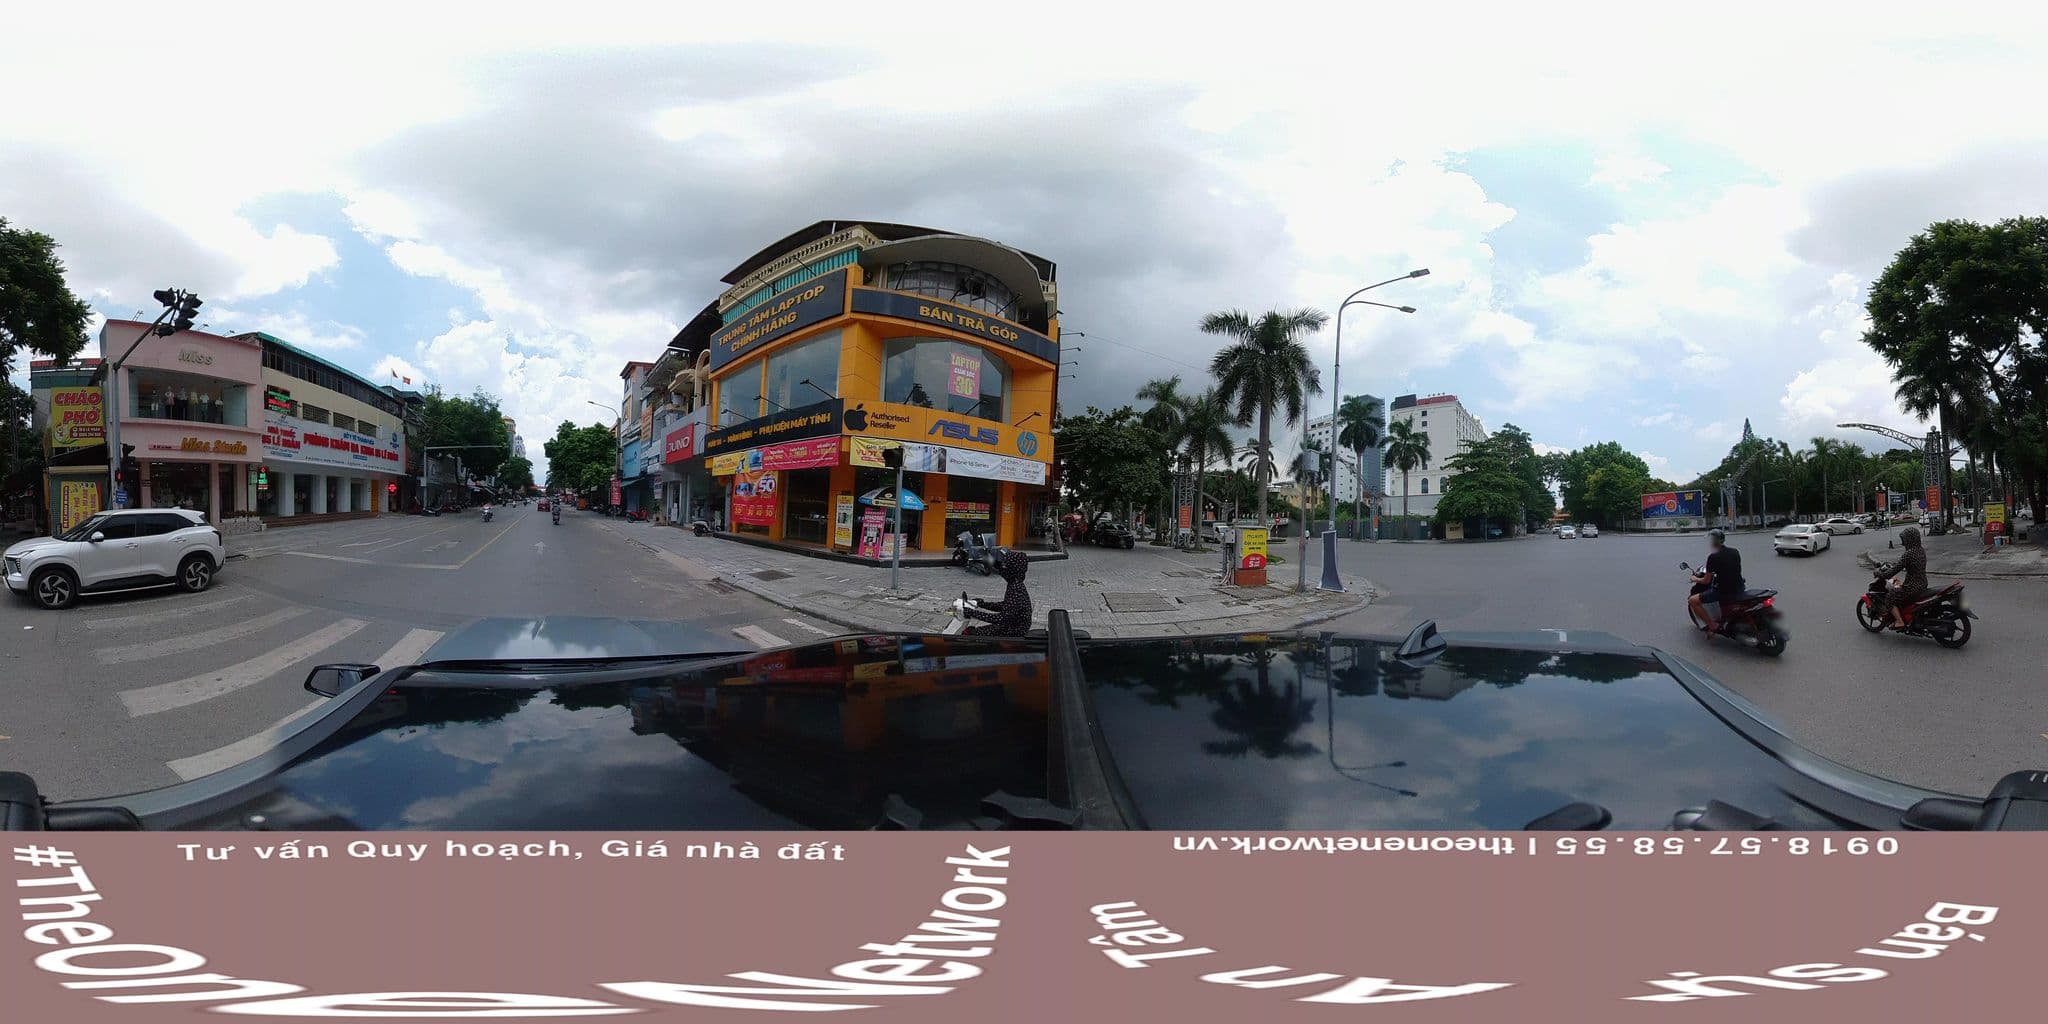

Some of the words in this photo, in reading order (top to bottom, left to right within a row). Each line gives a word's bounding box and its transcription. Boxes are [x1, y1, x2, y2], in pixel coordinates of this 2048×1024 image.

[718, 321, 747, 346] TRUNG
[748, 308, 769, 329] TÂM
[769, 284, 826, 320] LAPTOP
[918, 304, 954, 323] BÁN
[957, 312, 985, 331] TRẢ
[989, 325, 1019, 342] GÓP
[731, 327, 760, 353] CHÍNH
[760, 311, 797, 339] HÃNG
[179, 349, 213, 366] Miss
[952, 355, 980, 370] LAPTOP
[791, 416, 808, 428] MÁY
[810, 412, 831, 425] TÍNH
[870, 420, 897, 430] Reseller
[871, 412, 910, 424] Authorised
[928, 419, 998, 445] ASUS
[181, 437, 211, 453] Miss
[213, 440, 248, 455] Studio
[666, 435, 690, 454] JUNO
